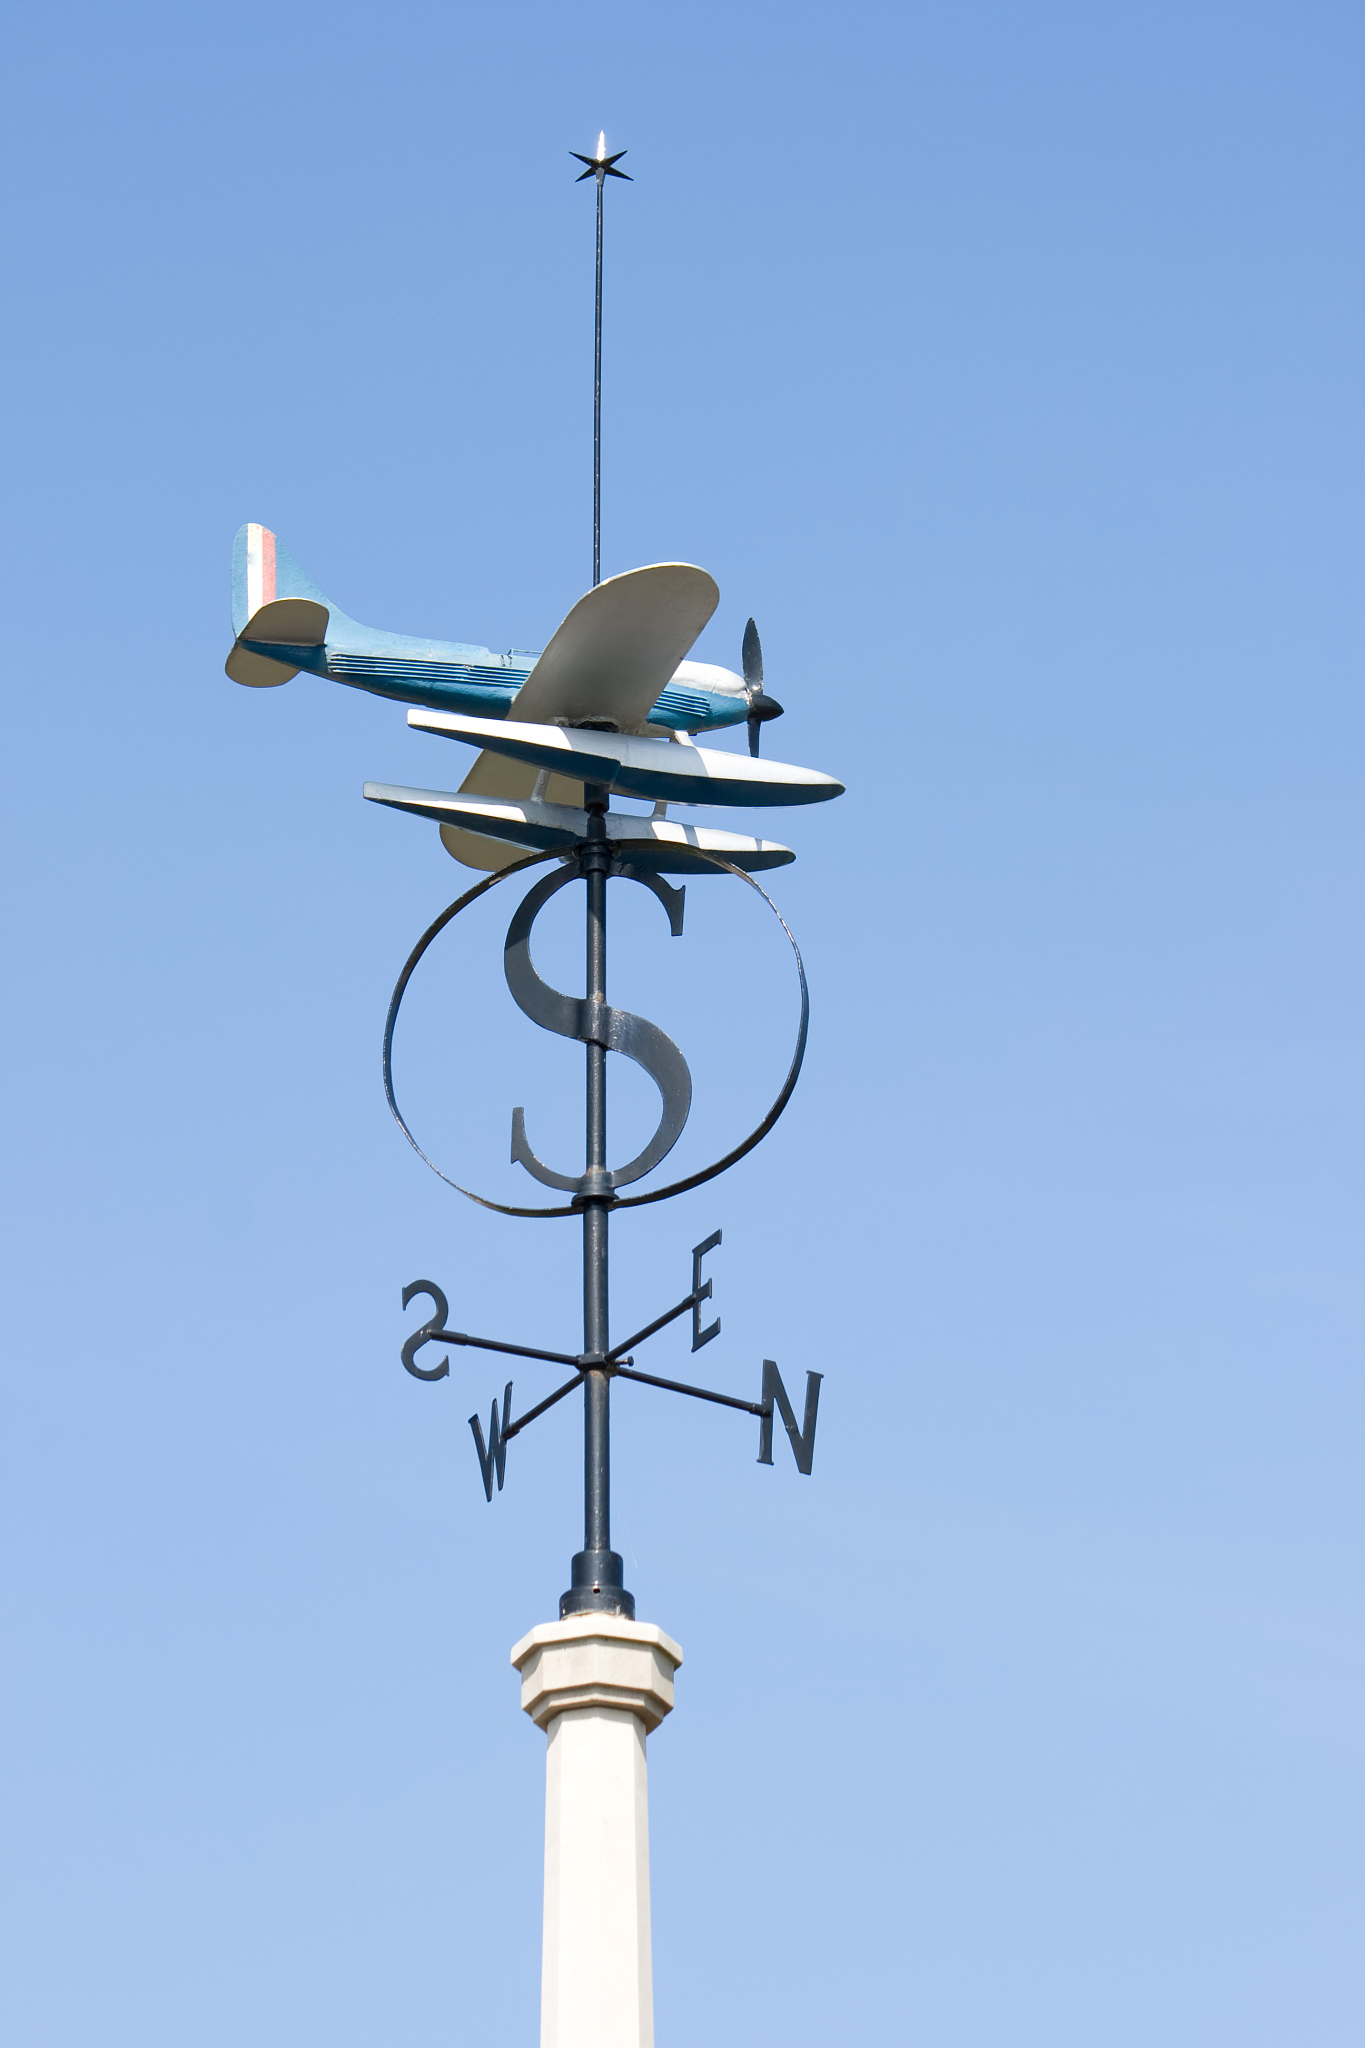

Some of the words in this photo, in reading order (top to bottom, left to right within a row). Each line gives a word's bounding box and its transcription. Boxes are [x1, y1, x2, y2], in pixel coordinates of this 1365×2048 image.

[504, 858, 692, 1192] S
[691, 1228, 722, 1353] E
[467, 1380, 514, 1503] W
[756, 1359, 825, 1476] N
